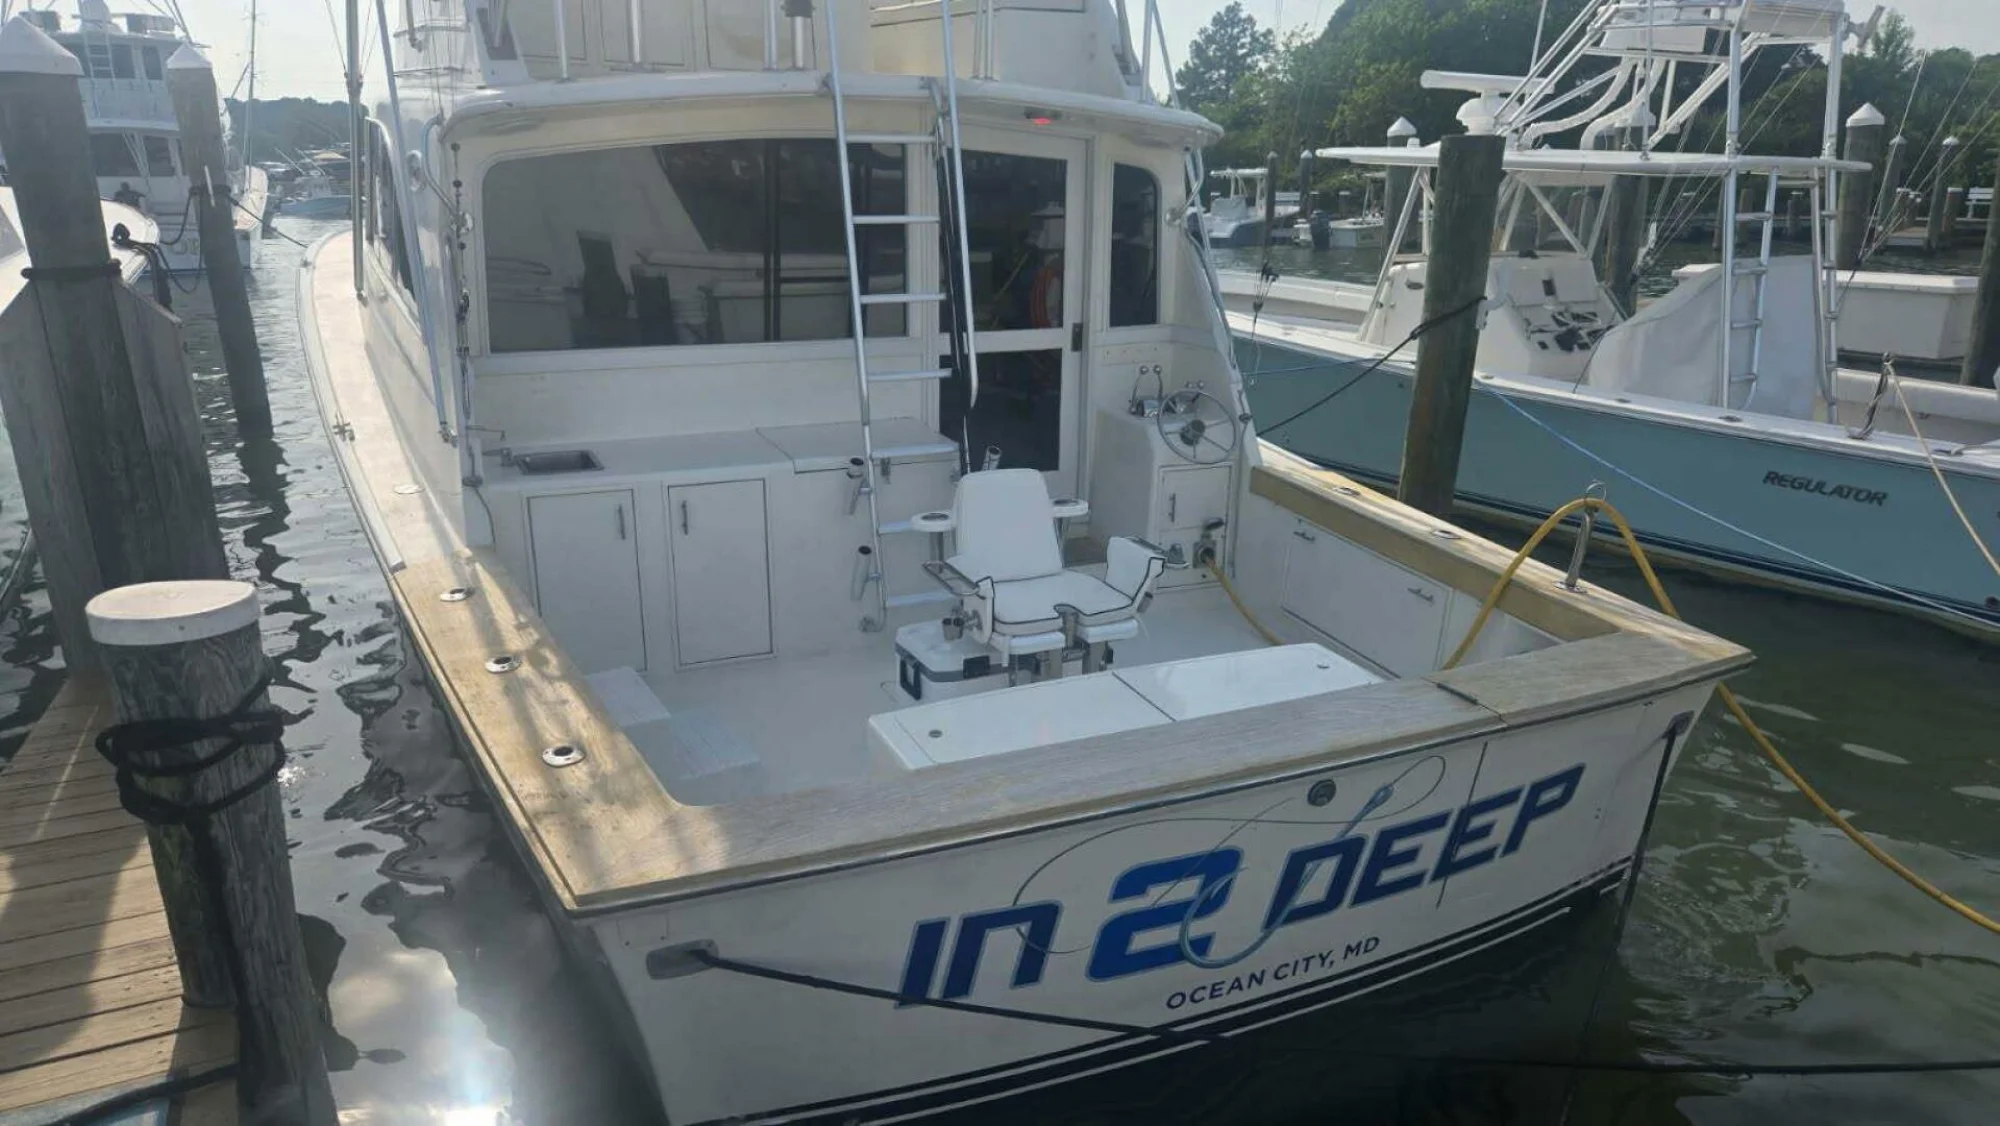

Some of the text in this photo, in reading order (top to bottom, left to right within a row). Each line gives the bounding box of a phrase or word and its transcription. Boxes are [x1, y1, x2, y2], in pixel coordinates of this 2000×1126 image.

[1762, 470, 1888, 507] REGULATOR
[1085, 844, 1245, 982] 2
[1260, 762, 1586, 934] DEEP
[1165, 935, 1381, 1010] OCEAN CITY, MD
